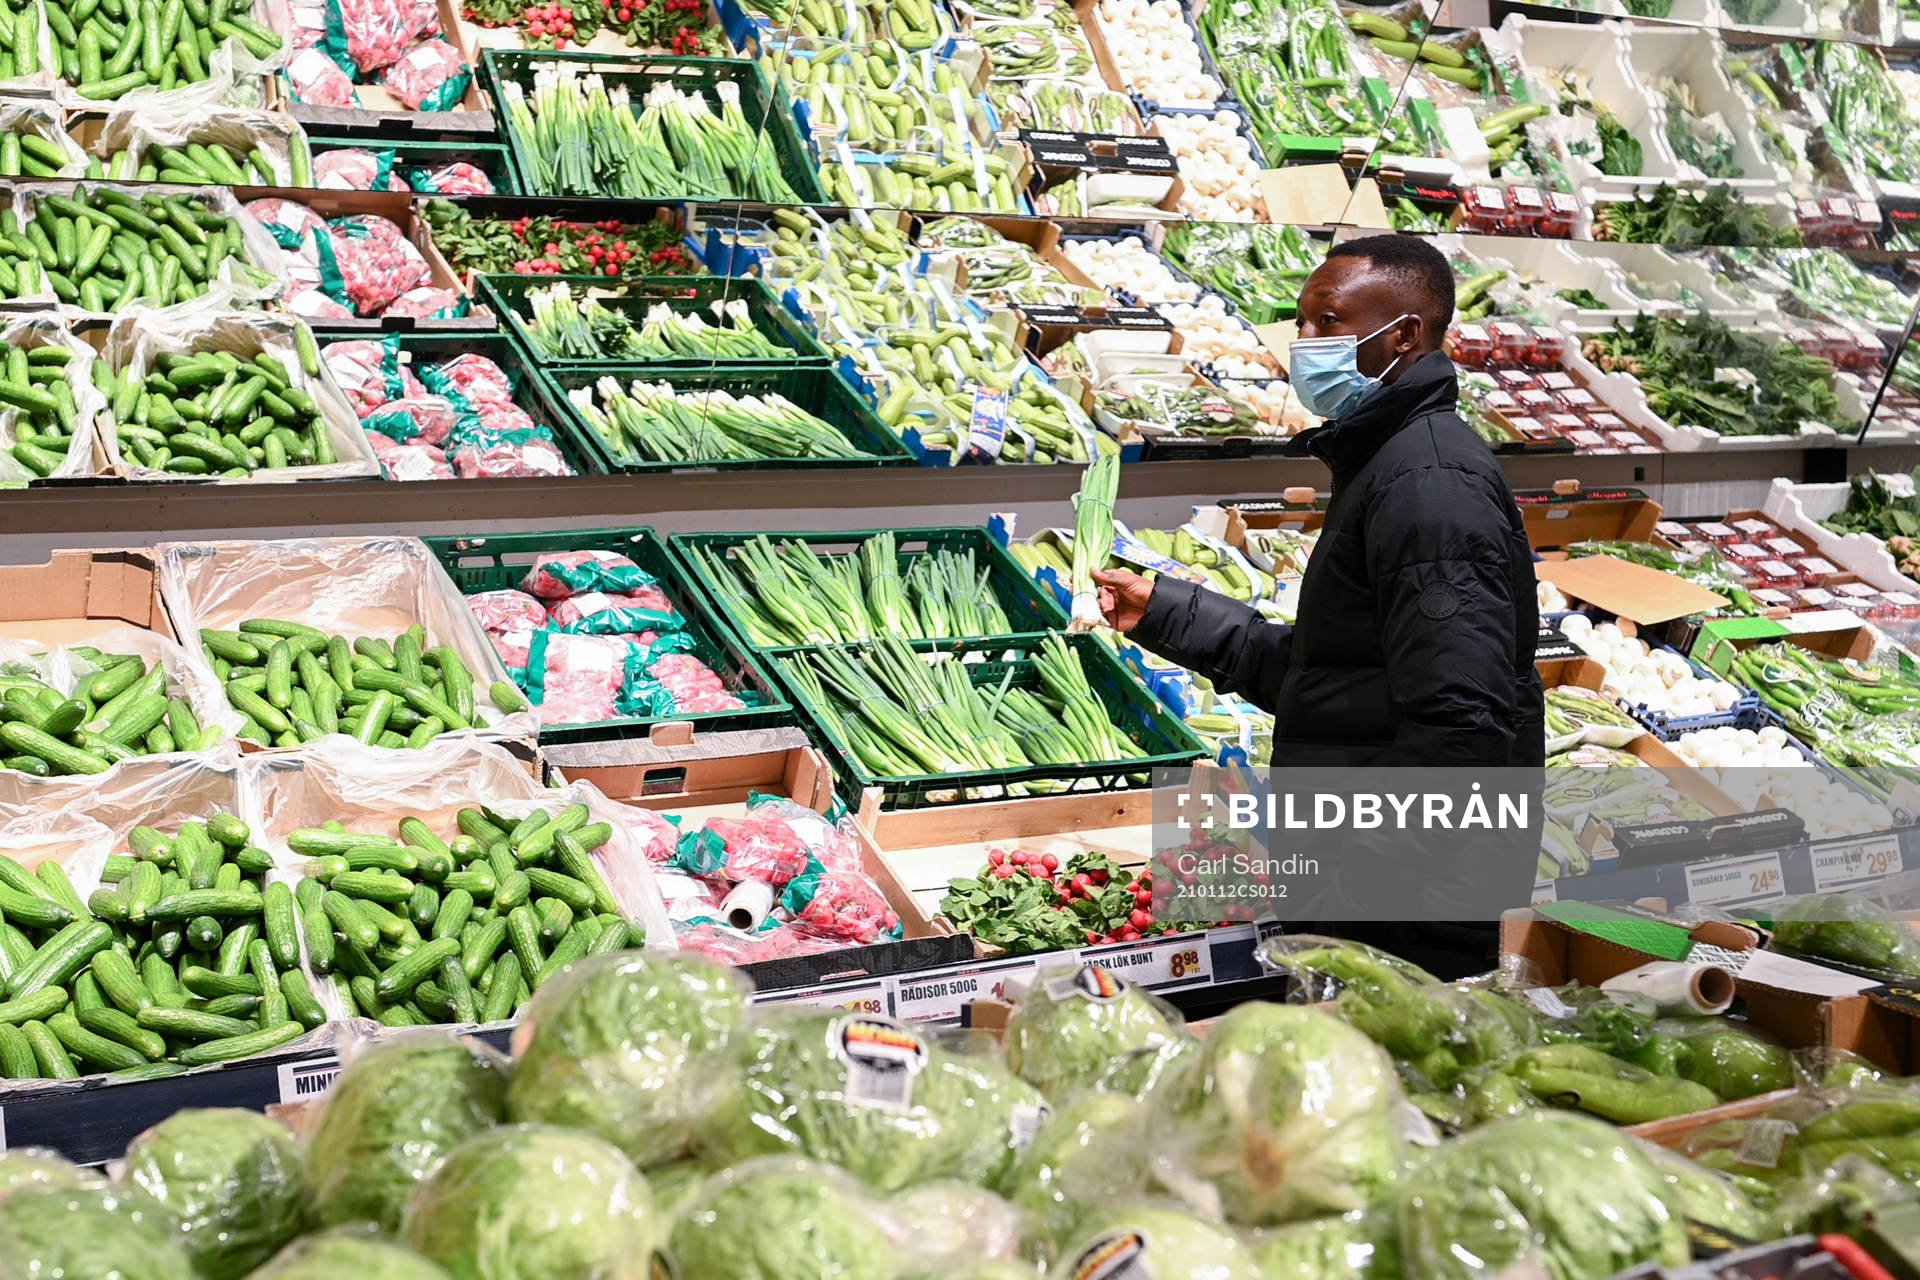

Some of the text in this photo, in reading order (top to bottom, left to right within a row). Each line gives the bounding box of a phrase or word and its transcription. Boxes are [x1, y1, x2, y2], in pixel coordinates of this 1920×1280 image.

[1113, 954, 1130, 968] LÖK
[1131, 951, 1153, 966] BUNT
[901, 982, 948, 1002] RÄDISOR
[950, 978, 978, 995] 500G
